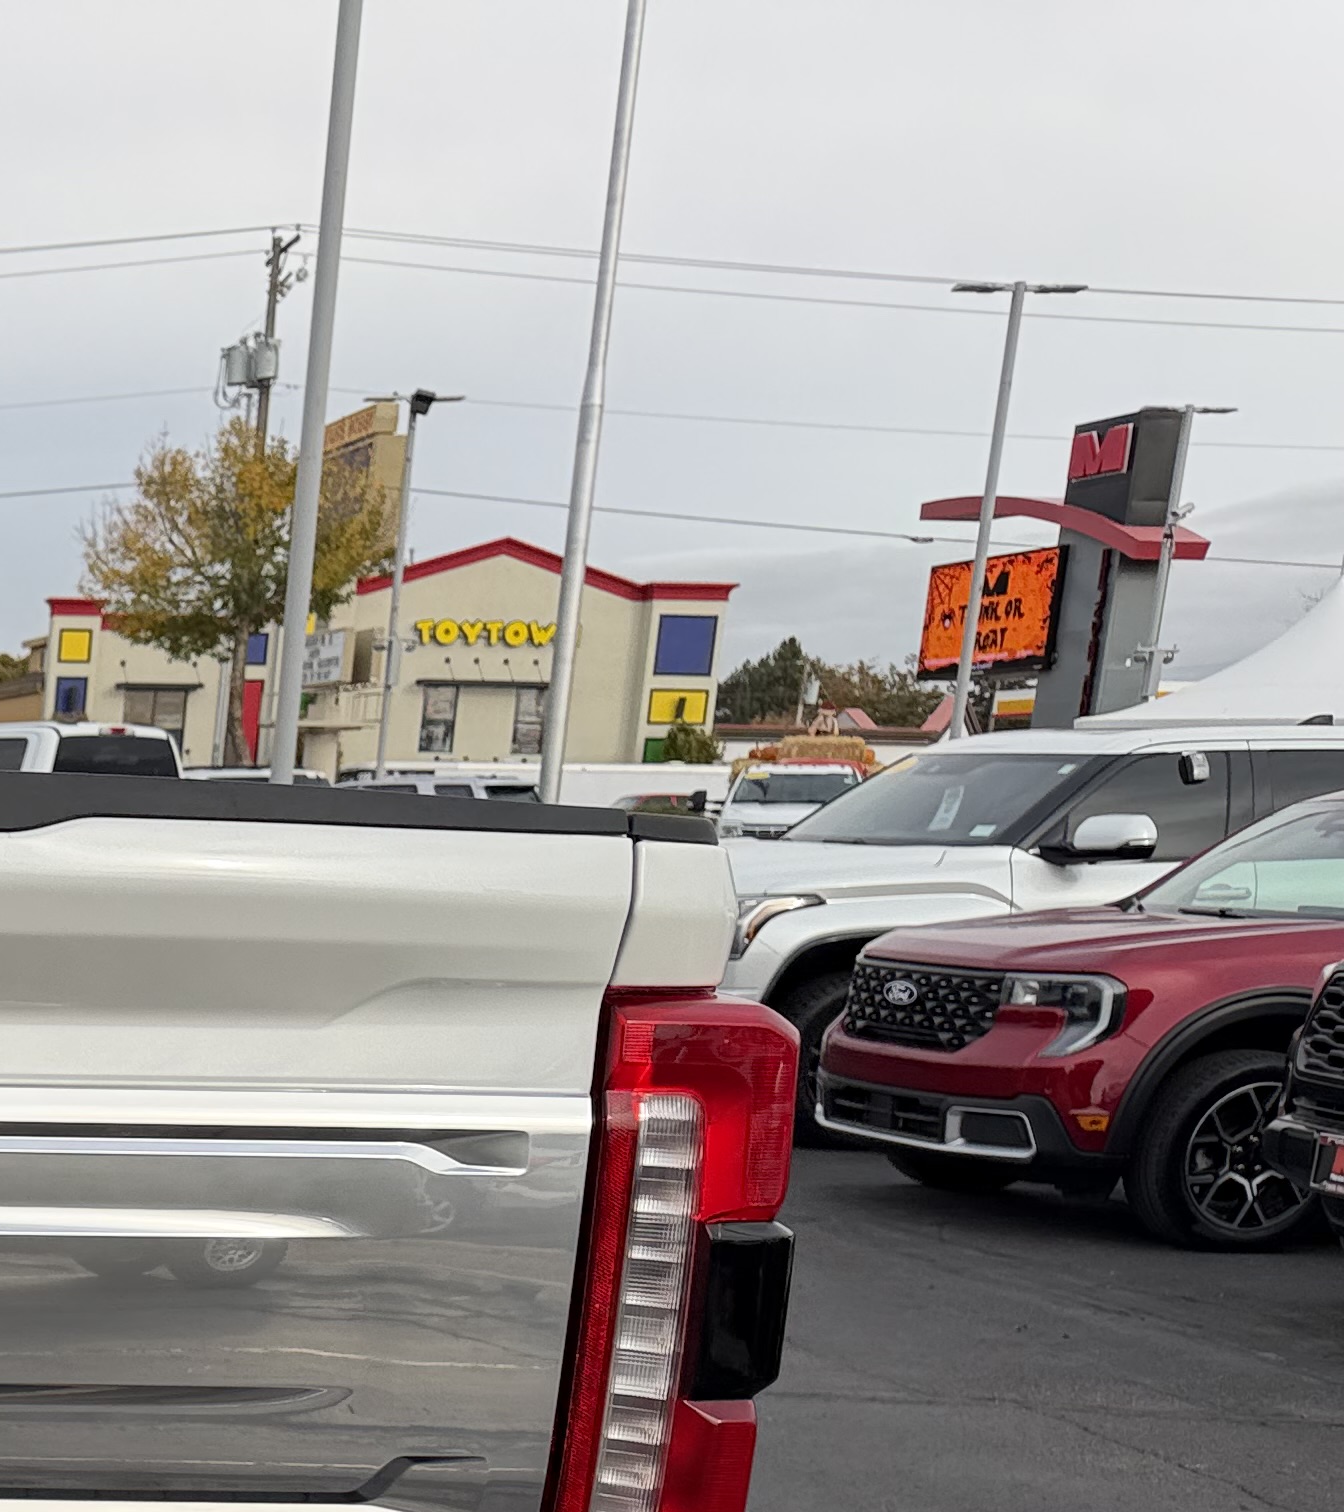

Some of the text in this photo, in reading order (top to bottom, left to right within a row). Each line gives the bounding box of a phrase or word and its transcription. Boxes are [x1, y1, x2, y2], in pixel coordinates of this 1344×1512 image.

[958, 598, 1025, 626] TNK OR
[415, 618, 582, 647] TOYTOW
